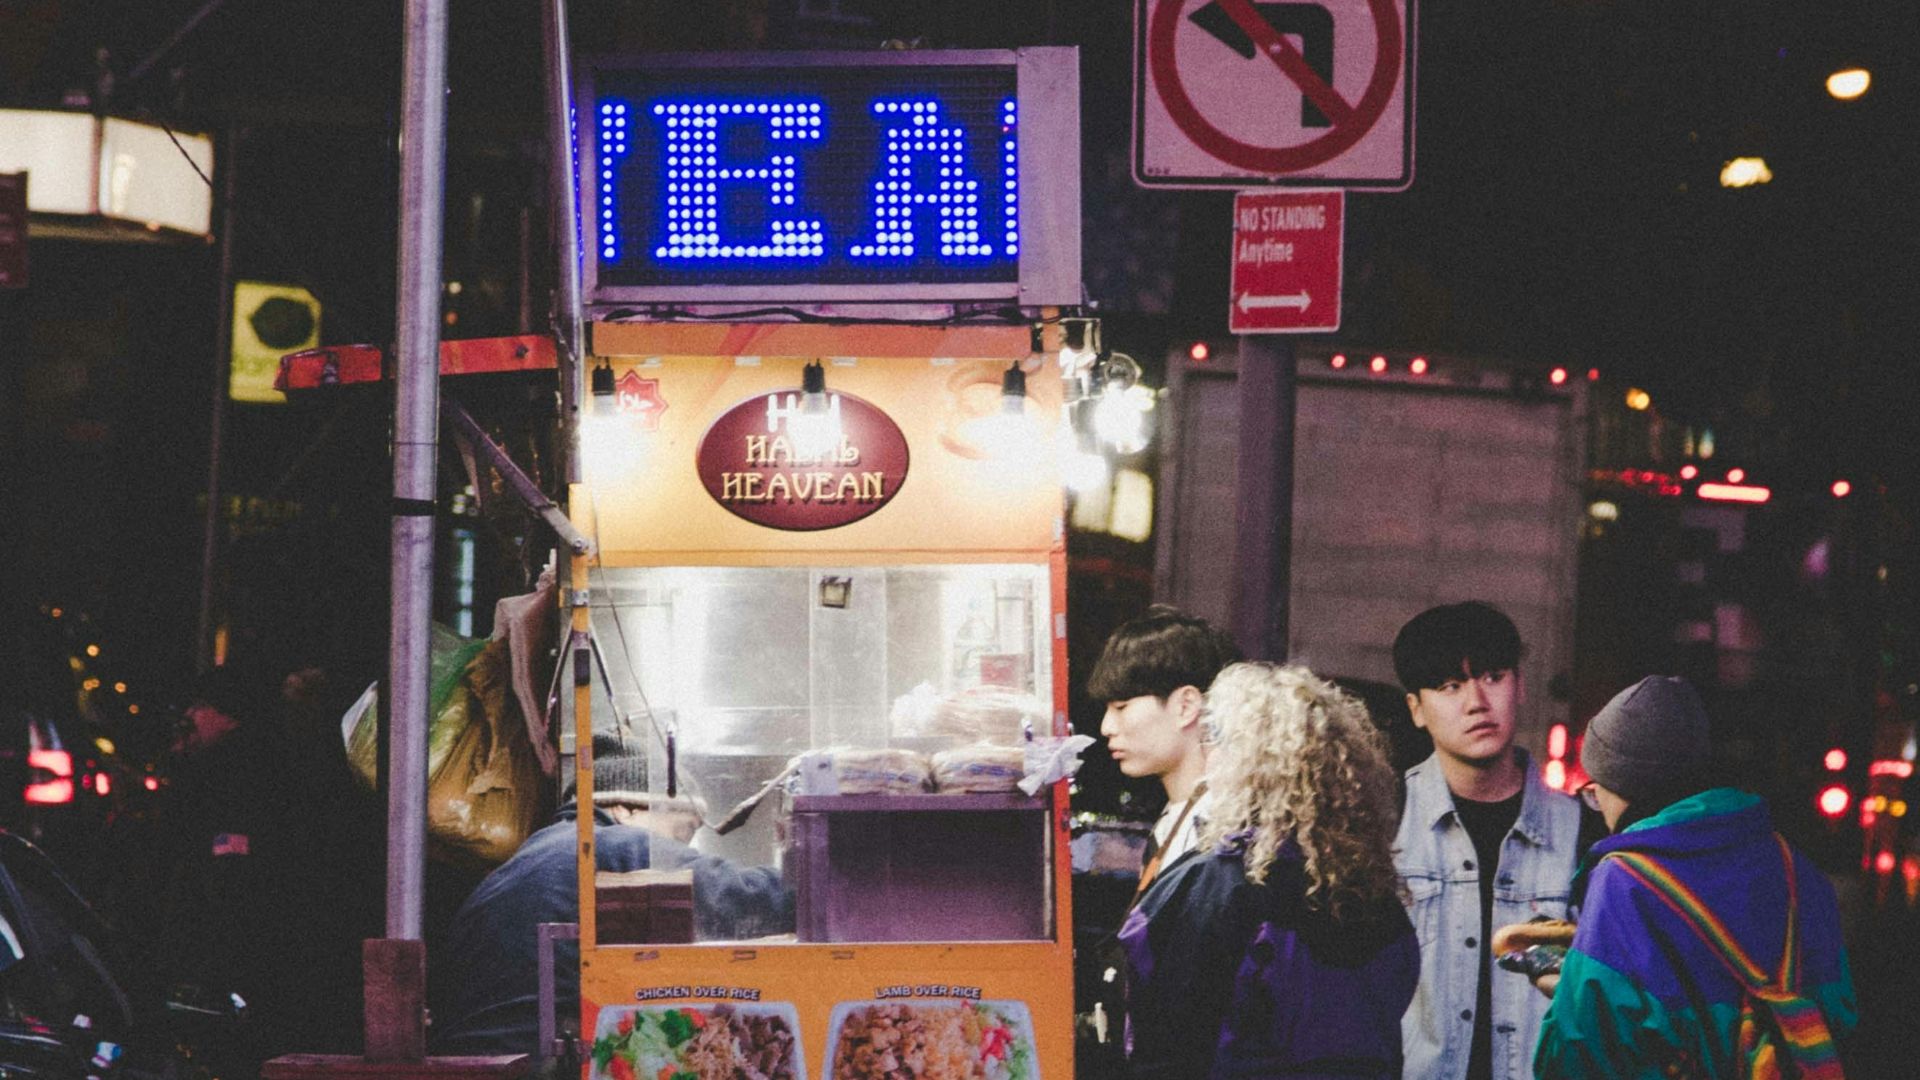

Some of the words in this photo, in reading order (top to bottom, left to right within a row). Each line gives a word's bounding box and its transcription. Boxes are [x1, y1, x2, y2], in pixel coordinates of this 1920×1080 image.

[1239, 207, 1259, 232] NO
[1261, 205, 1326, 232] STANDING
[1239, 238, 1294, 269] Anytime
[721, 471, 885, 501] HEAVEAN
[635, 987, 690, 1000] CHICKEN
[693, 986, 728, 998] OVER
[729, 987, 761, 1000] RICE
[875, 986, 912, 999] LAMB
[914, 985, 949, 998] OVER
[950, 986, 982, 999] RICE
